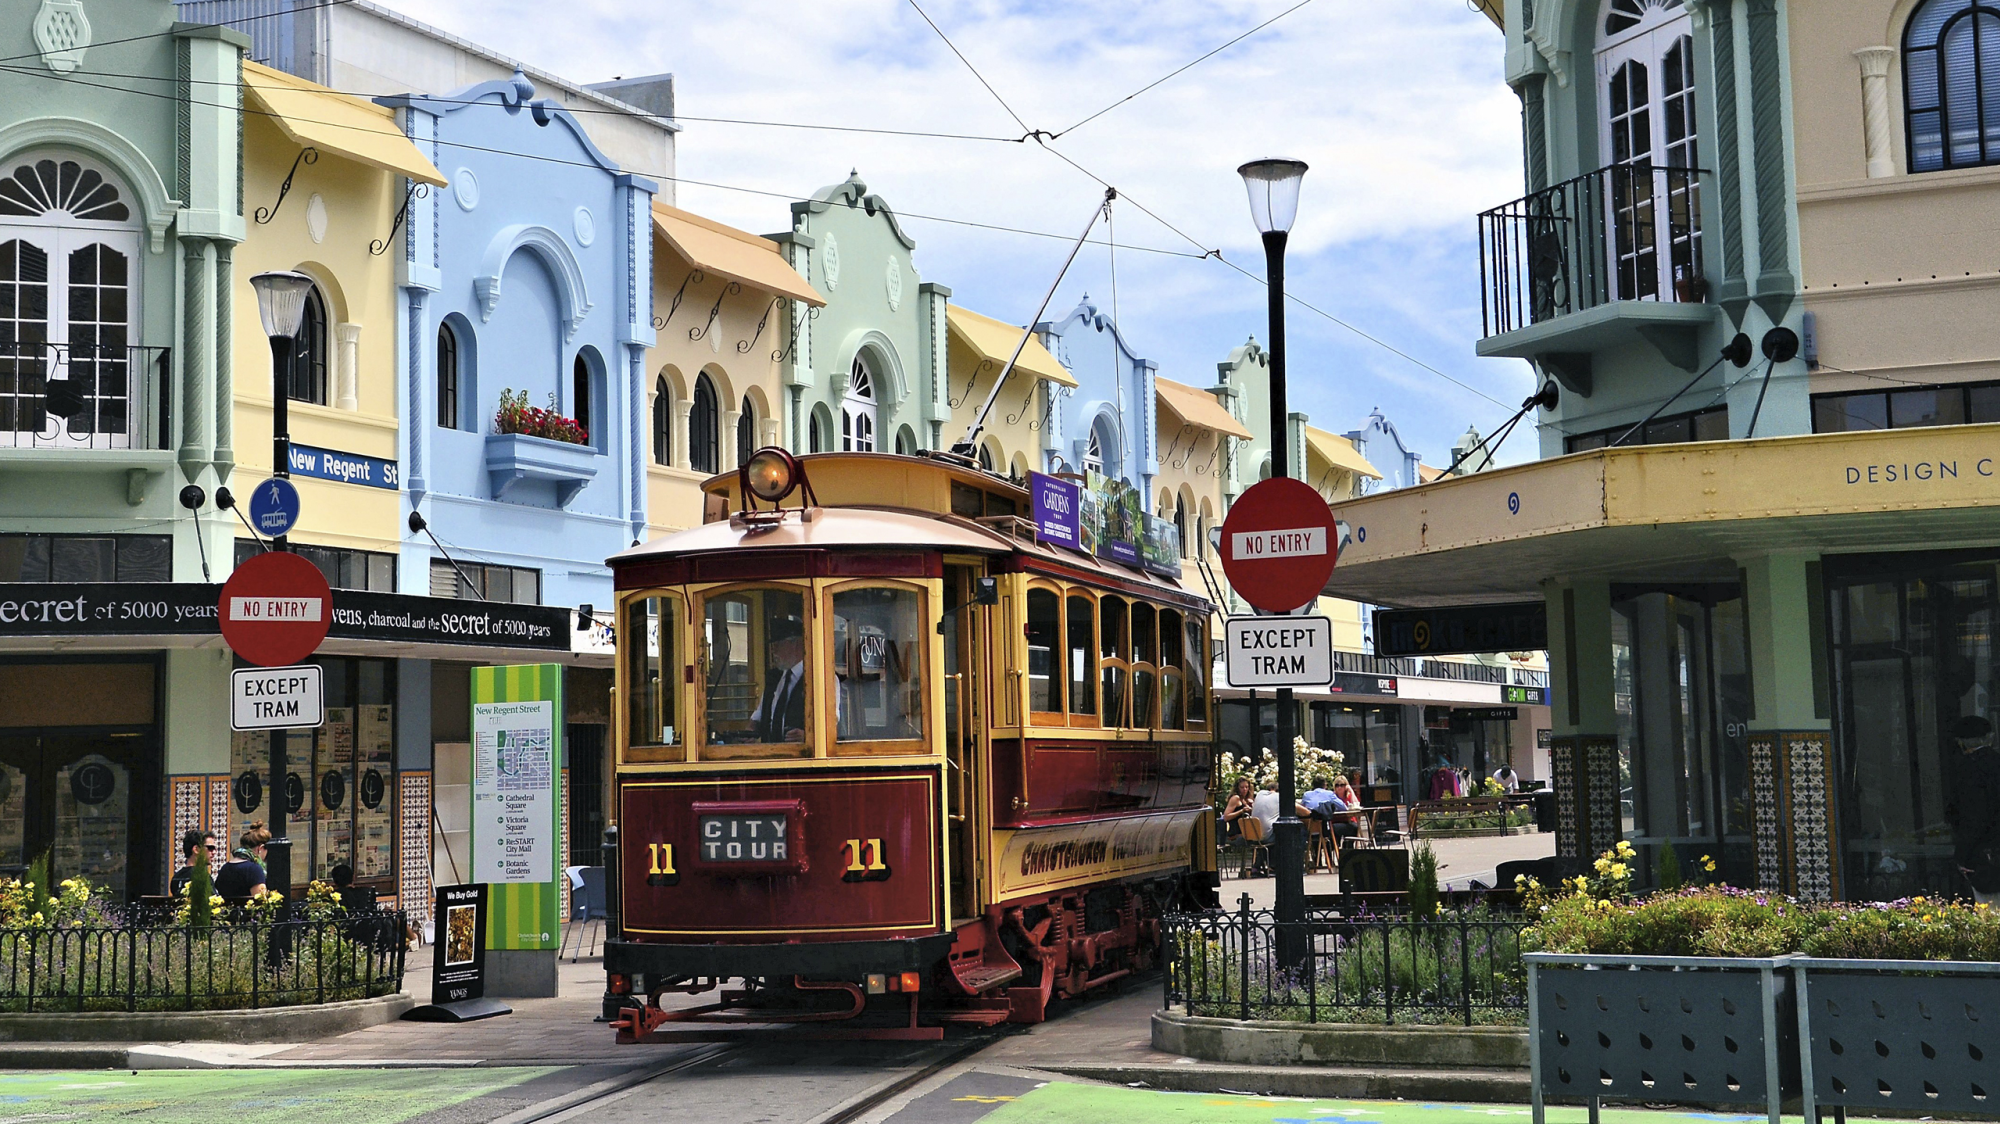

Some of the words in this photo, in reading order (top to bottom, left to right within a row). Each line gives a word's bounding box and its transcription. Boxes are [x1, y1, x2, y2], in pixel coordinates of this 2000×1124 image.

[289, 448, 316, 471] New
[323, 453, 370, 483] Regent
[383, 463, 398, 485] St
[1846, 461, 1958, 484] DESIGN
[1043, 489, 1070, 515] GARDENS
[1246, 535, 1262, 554] NO
[1270, 532, 1312, 553] ENTRY
[94, 602, 116, 619] of
[120, 601, 168, 619] 5000
[243, 601, 260, 617] NO
[267, 601, 308, 617] ENTRY
[368, 610, 411, 629] charcoal
[412, 616, 426, 629] and
[428, 617, 440, 630] the
[441, 612, 490, 636] secret
[492, 619, 502, 634] of
[504, 619, 527, 636] 5000
[529, 623, 551, 641] years
[1241, 628, 1316, 649] EXCEPT
[1251, 655, 1305, 675] TRAM
[245, 677, 308, 696] EXCEPT
[253, 700, 299, 718] TRAM
[476, 706, 492, 715] New
[493, 706, 518, 716] Regent
[519, 705, 541, 713] Street
[505, 794, 535, 802] Cathedral
[505, 802, 527, 810] Square
[505, 824, 527, 832] Square
[704, 820, 787, 838] CITY
[505, 846, 518, 854] City
[518, 845, 532, 853] Mall
[704, 842, 787, 859] TOUR
[846, 838, 886, 871] 11
[648, 843, 676, 875] 11
[447, 892, 455, 900] We
[455, 891, 465, 900] Buy
[466, 890, 478, 898] Gold
